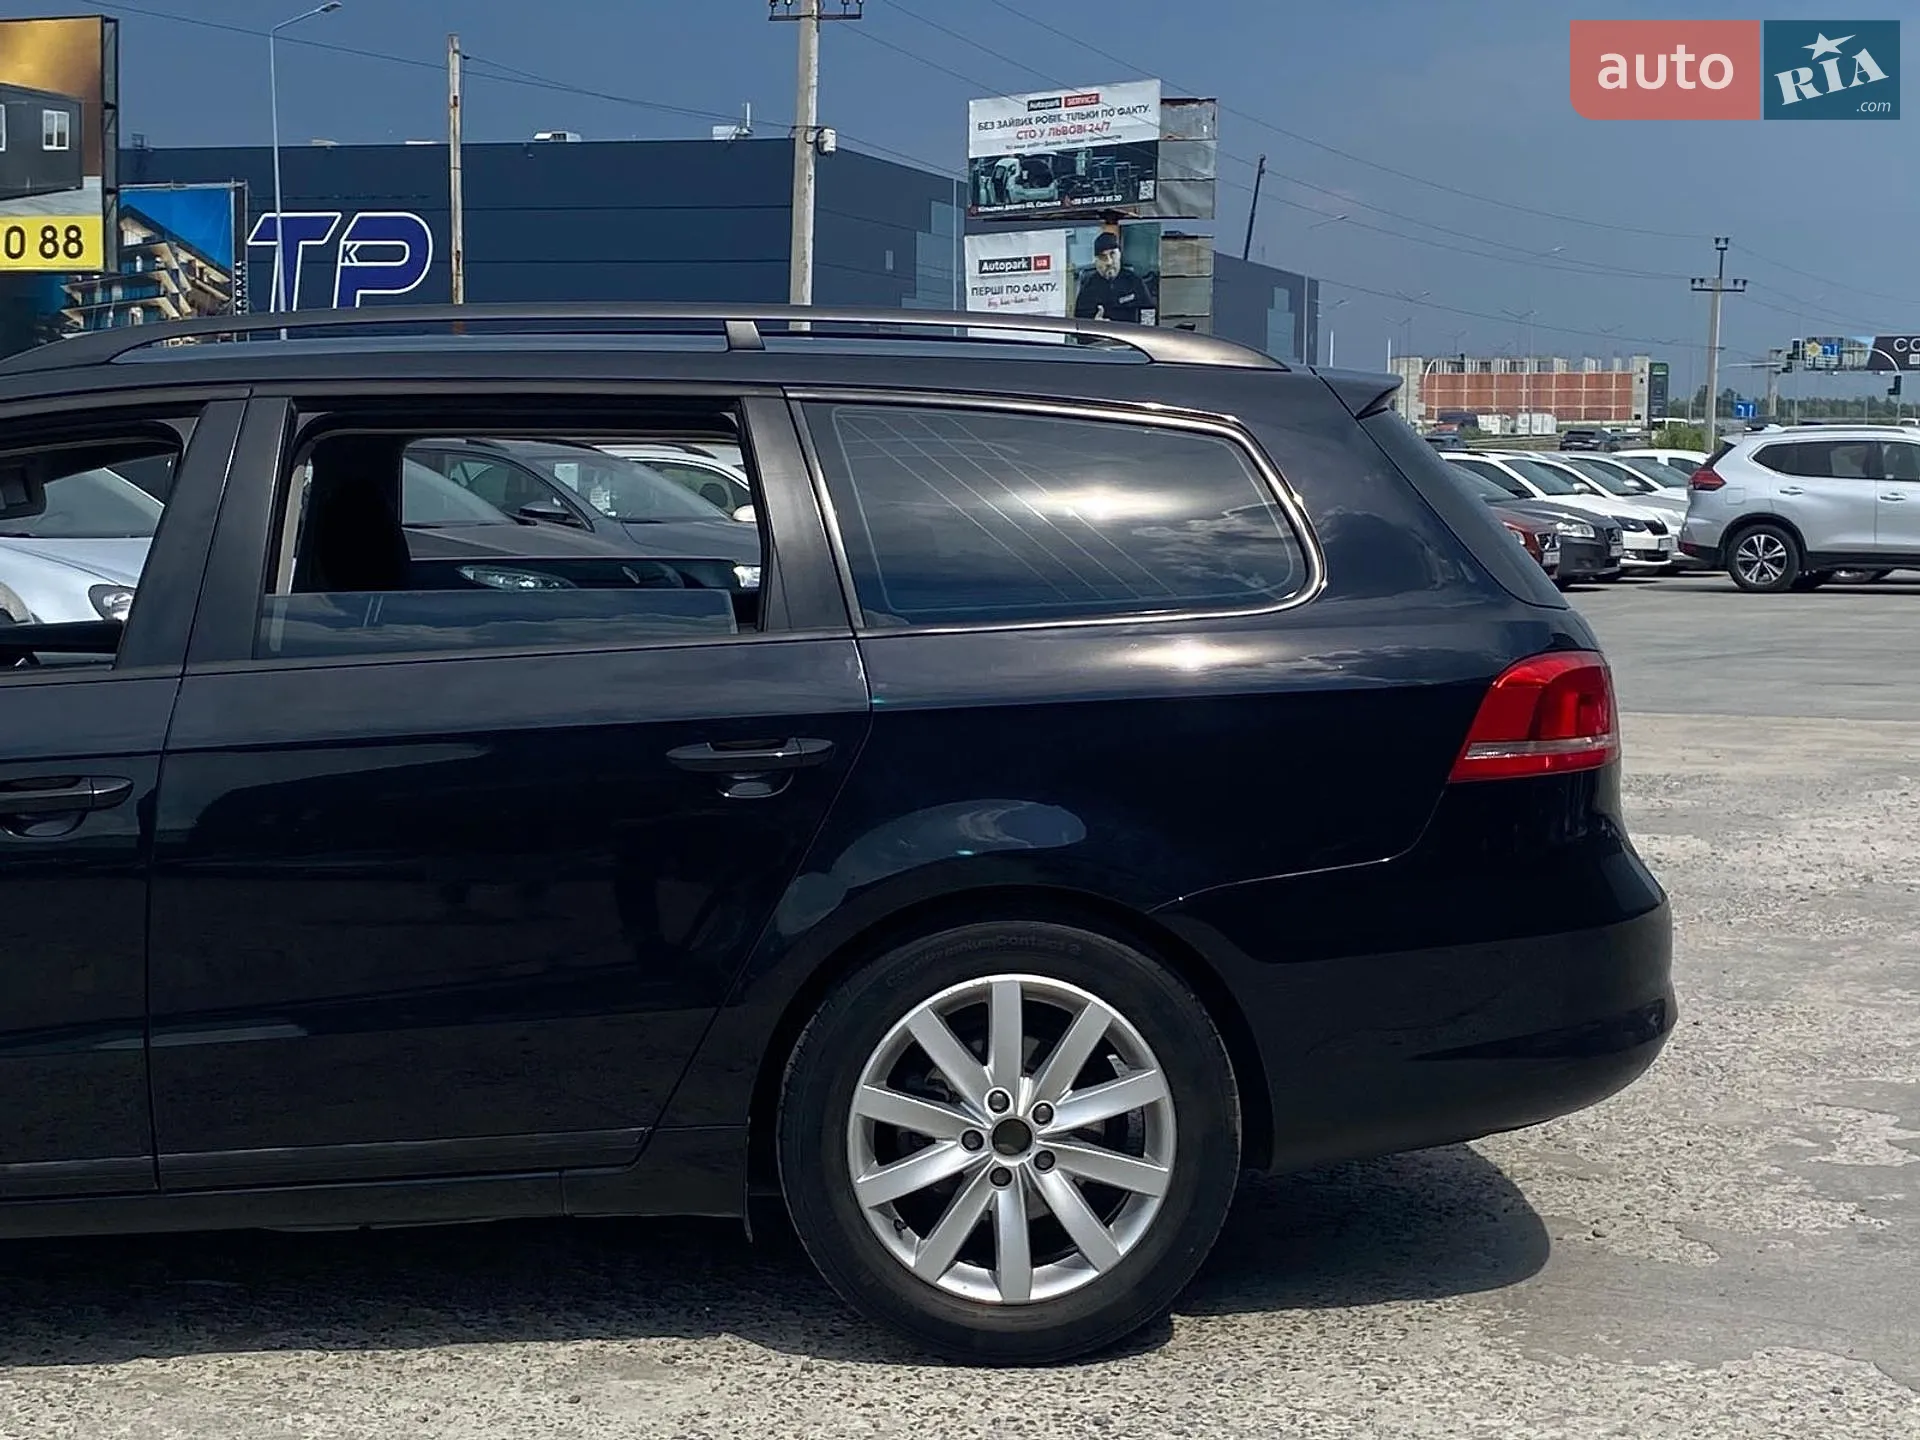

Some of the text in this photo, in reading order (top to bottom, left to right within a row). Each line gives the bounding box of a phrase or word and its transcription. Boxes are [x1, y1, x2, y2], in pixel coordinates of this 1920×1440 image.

[978, 121, 995, 131] БЕЗ
[1101, 108, 1115, 118] ПО
[1016, 129, 1037, 140] СТО
[39, 224, 84, 260] 88
[981, 257, 1029, 272] Autopark
[971, 285, 1004, 297] ПЕРШІ
[1006, 284, 1021, 295] ПО
